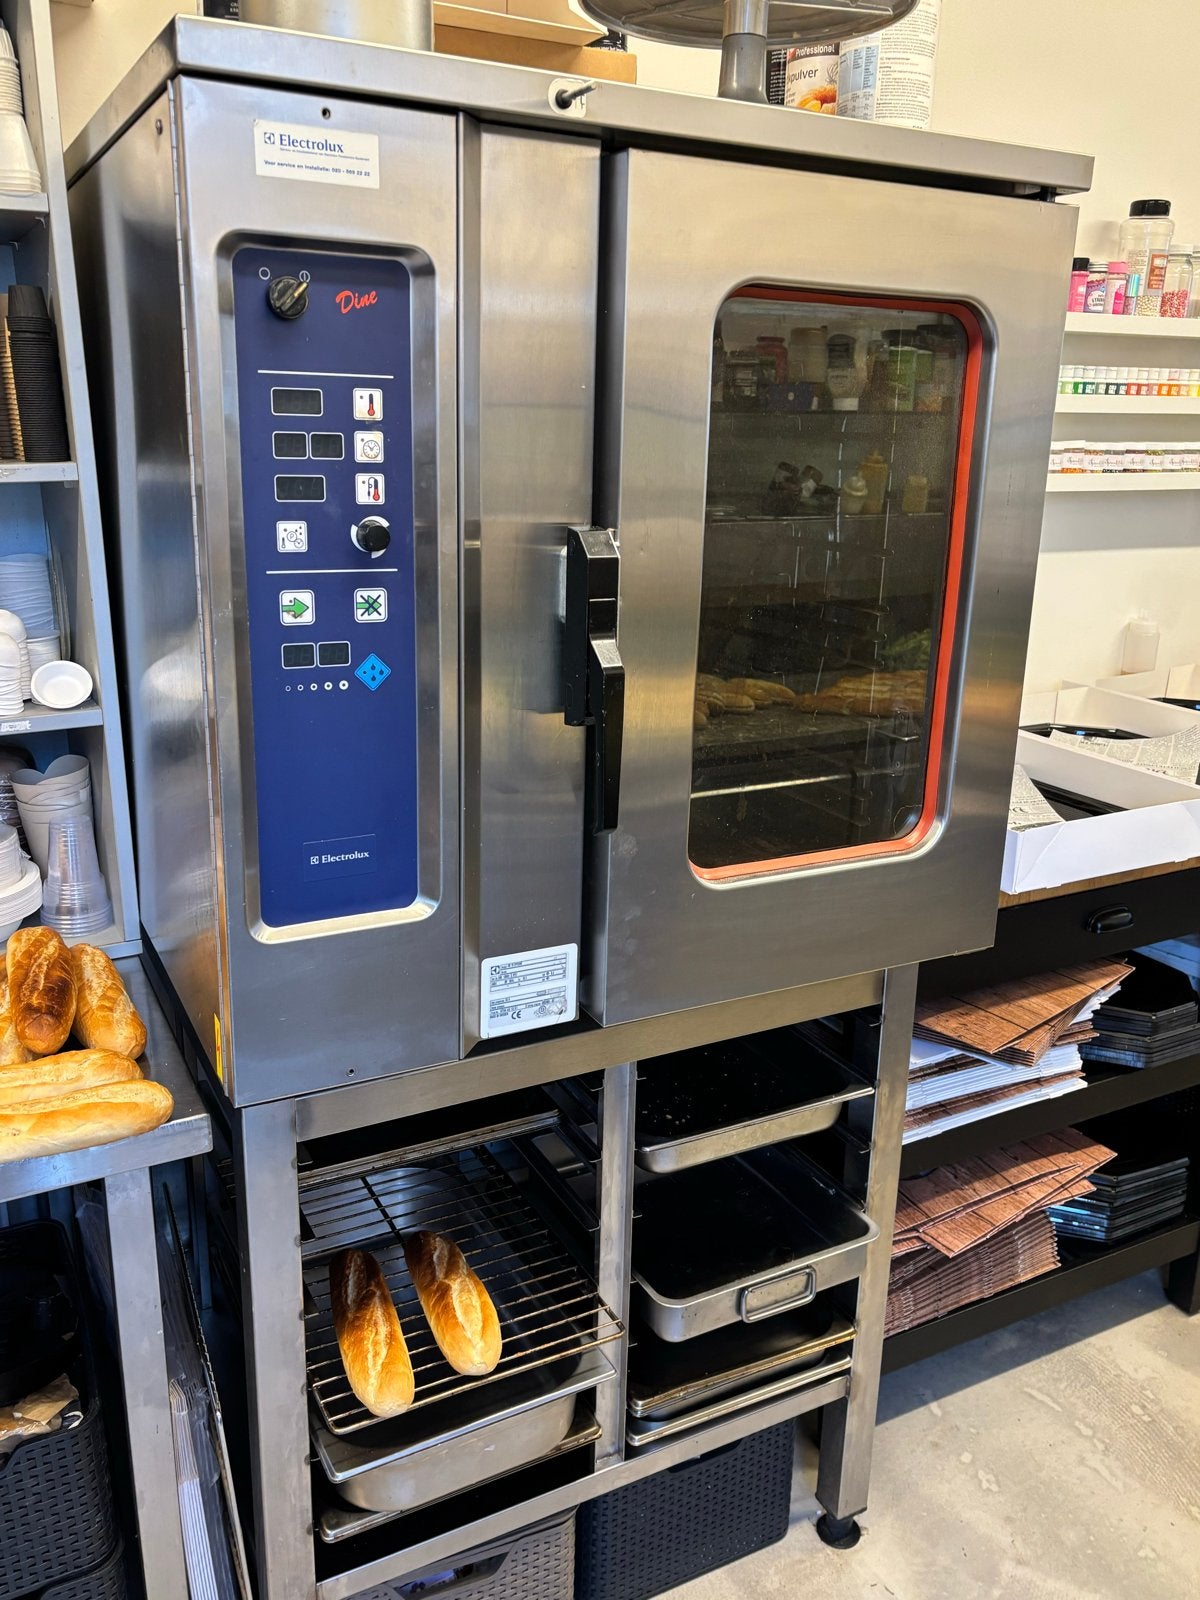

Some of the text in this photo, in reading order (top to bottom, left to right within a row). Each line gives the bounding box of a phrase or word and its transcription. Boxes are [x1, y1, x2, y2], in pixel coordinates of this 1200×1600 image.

[795, 44, 835, 57] Professional
[279, 133, 344, 153] Electrolux
[335, 290, 378, 314] Dine
[321, 851, 370, 864] Electrolux
